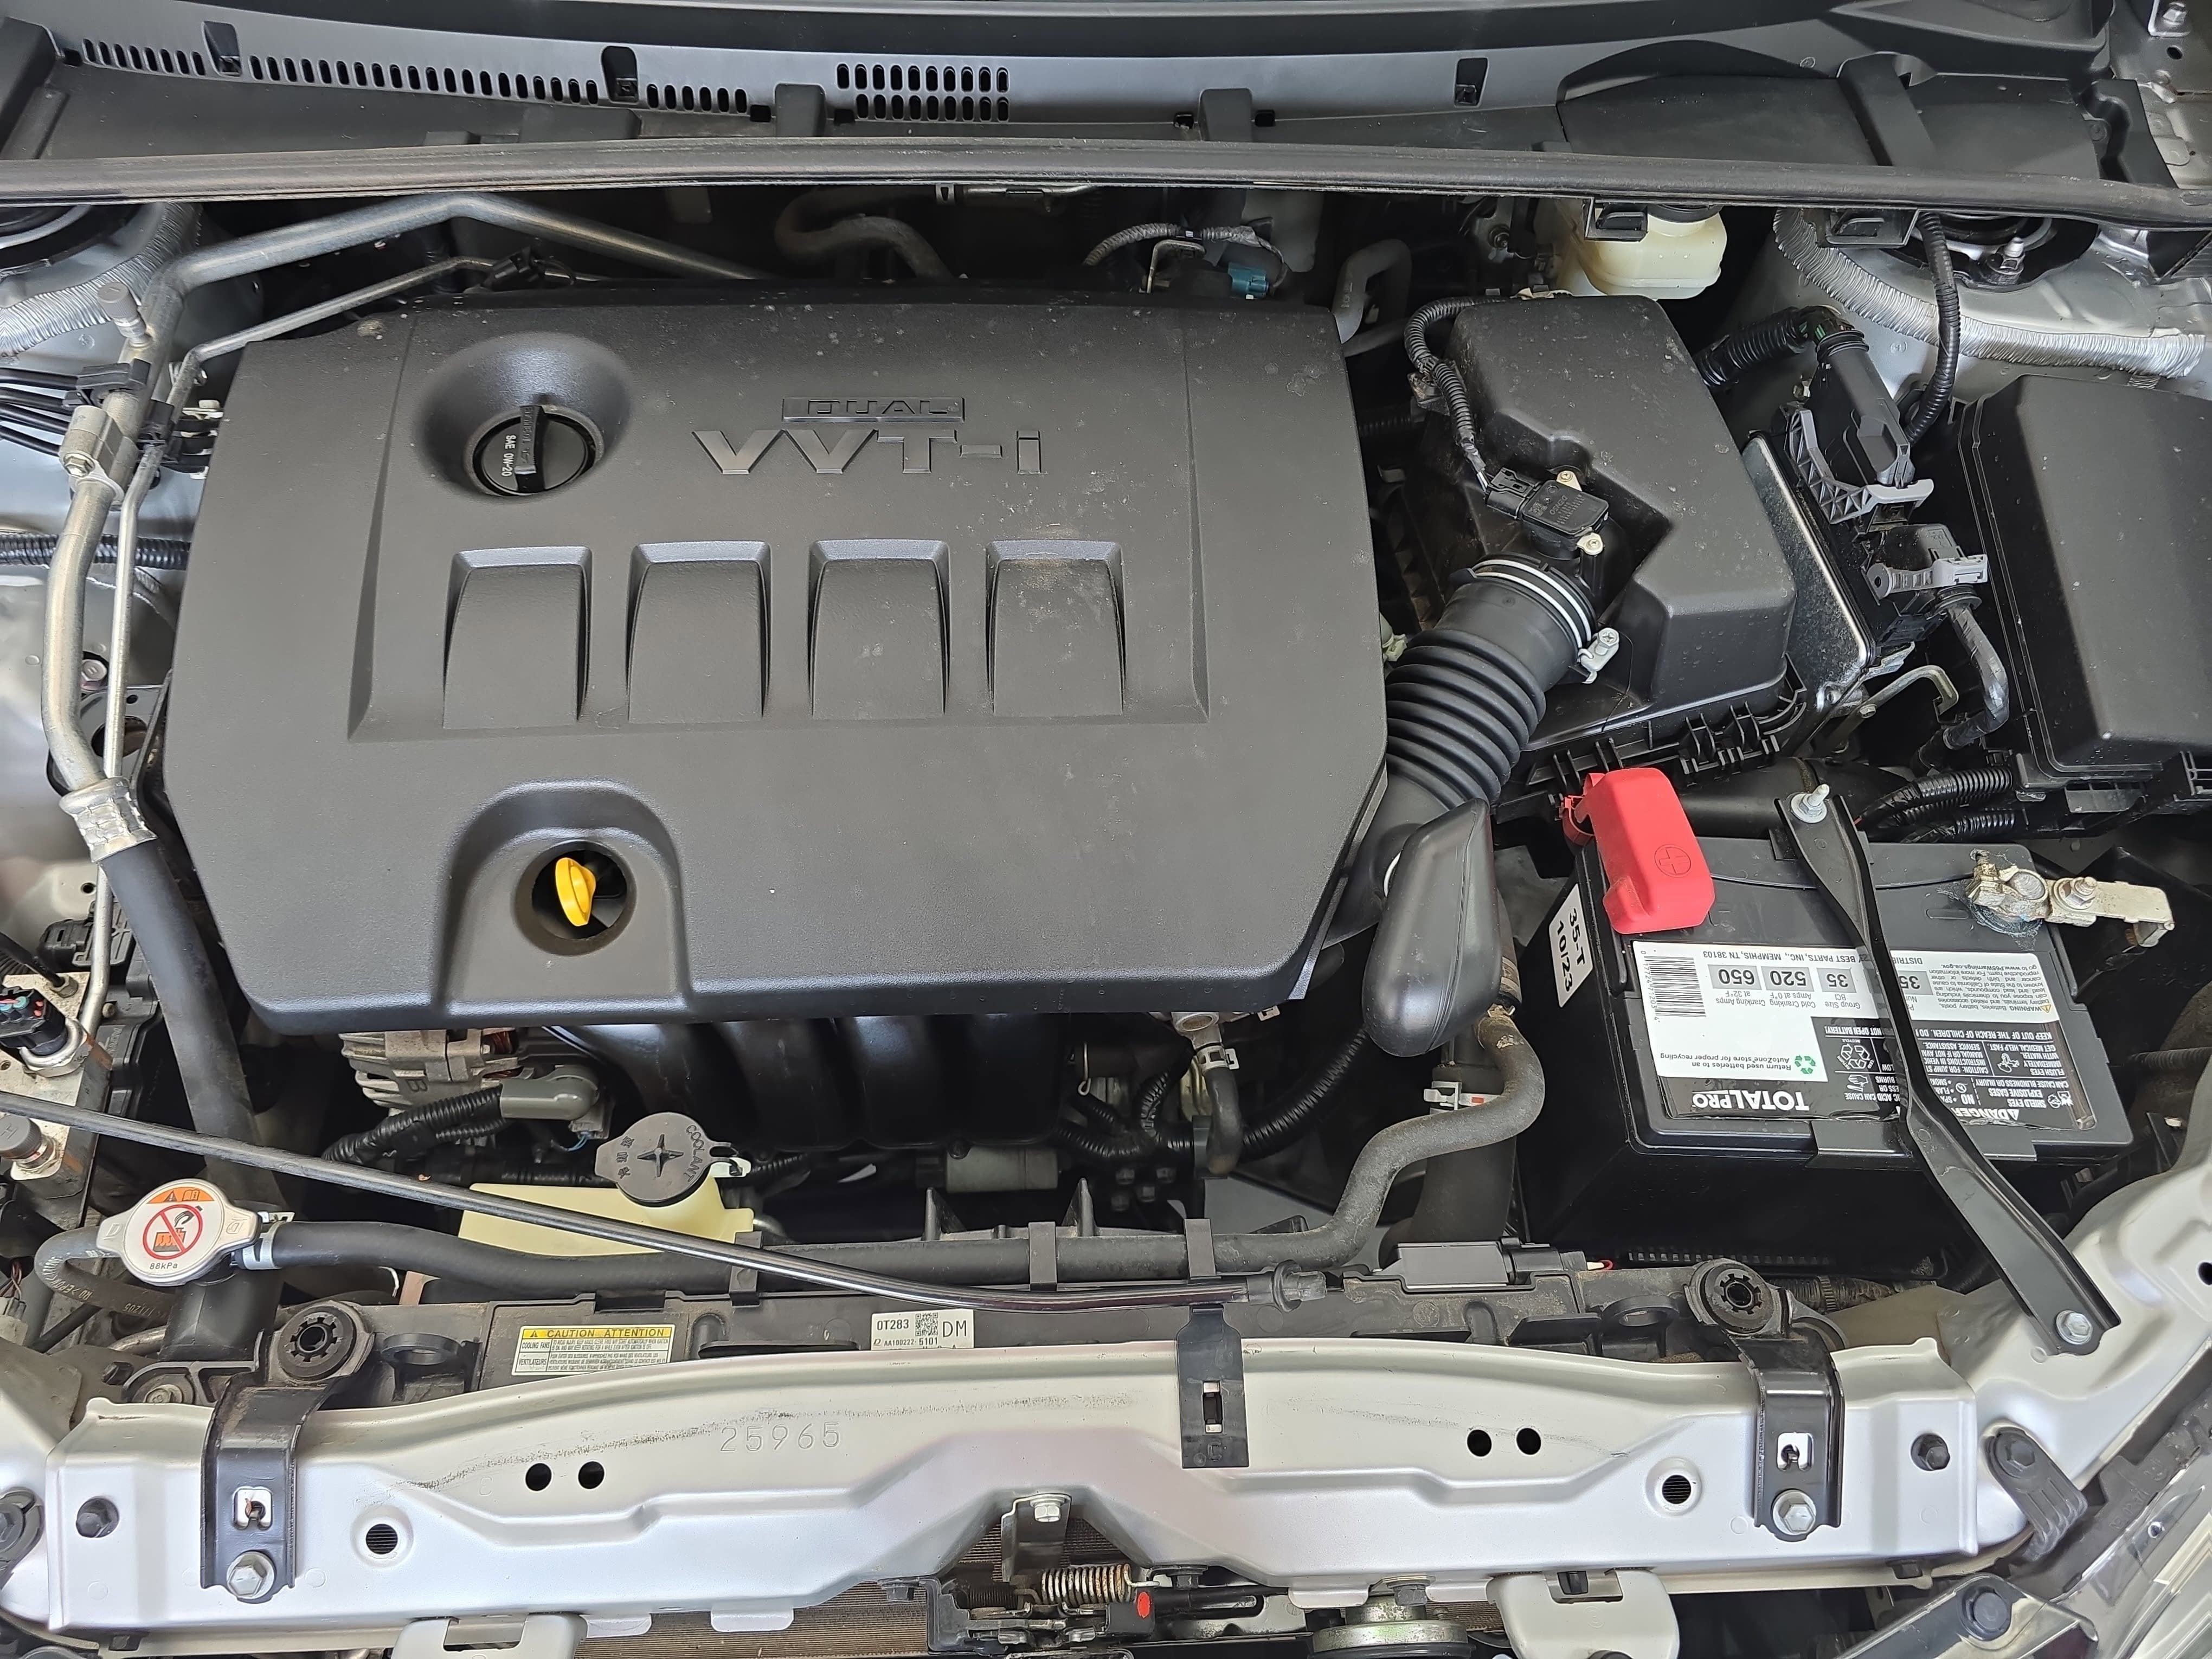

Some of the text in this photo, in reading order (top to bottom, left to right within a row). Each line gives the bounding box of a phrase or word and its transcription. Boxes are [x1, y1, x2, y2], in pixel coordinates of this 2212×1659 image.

[807, 399, 949, 415] DUAL
[501, 434, 517, 477] SAE 0W-20
[692, 429, 1043, 474] VVT-i
[1570, 908, 1585, 965] 35-T
[1557, 920, 1573, 992] 10/23
[1741, 951, 1781, 960] MEMPHIS,
[1785, 953, 1804, 961] INC.,
[1805, 953, 1834, 962] PARTS,
[1892, 956, 1923, 965] DISTRIB
[1718, 969, 1754, 985] 650
[1770, 970, 1806, 986] 520
[1827, 974, 1848, 987] 35
[1792, 992, 1811, 1000] Amps
[1715, 997, 1766, 1006] Cranking Amps
[1770, 999, 1799, 1007] Cranking
[1824, 1026, 1854, 1035] BATTERY!
[1854, 1027, 1869, 1036] OPEN
[1870, 1027, 1882, 1036] NOT
[1931, 1029, 1964, 1037] CHILDREN.
[1922, 1041, 1957, 1050] ASSISTANCE.
[1875, 1076, 1895, 1084] BURNS
[1975, 1078, 1995, 1086] INJURY
[2036, 1079, 2054, 1088] CAUSE
[1844, 1092, 1863, 1101] CAUSE
[1864, 1093, 1876, 1101] CAN
[1988, 1088, 2041, 1097] EXPLOSIVE GASES
[1692, 1090, 1810, 1111] TOTALPRO
[1876, 1093, 1892, 1102] ACID
[1960, 1094, 1974, 1104] NO
[2007, 1098, 2046, 1108] SHIELD EYES
[1950, 1107, 2006, 1119] DANGER
[684, 1125, 705, 1182] COOLANT
[604, 1328, 664, 1336] ATTENTION
[943, 1320, 967, 1338] DM
[720, 1421, 841, 1452] 25965
